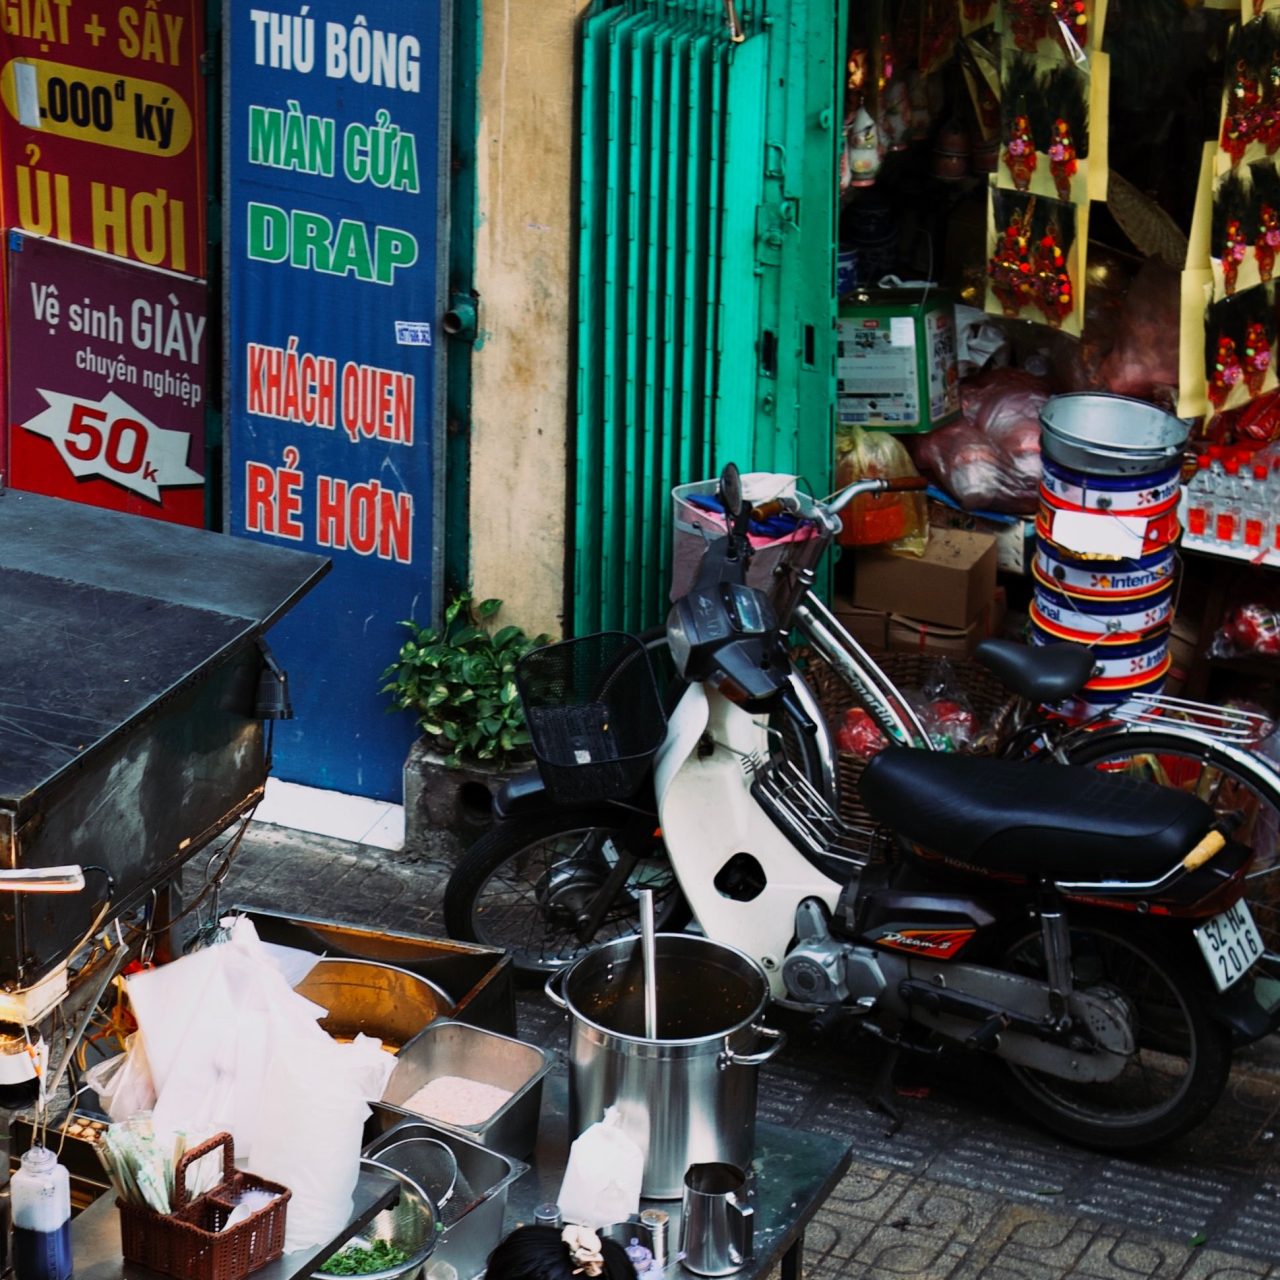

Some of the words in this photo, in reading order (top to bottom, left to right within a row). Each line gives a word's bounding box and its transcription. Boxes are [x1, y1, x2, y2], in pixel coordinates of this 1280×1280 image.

[250, 5, 315, 74] THÚ
[326, 15, 420, 92] BÔNG
[134, 93, 174, 150] ký
[249, 100, 335, 177] MÀN
[344, 109, 419, 192] CỬA
[16, 143, 72, 243] ỦI
[91, 181, 186, 272] HƠI
[247, 201, 418, 285] DRAP
[31, 282, 60, 335] Vệ
[68, 297, 124, 344] sinh
[130, 293, 207, 365] GIÀY
[76, 346, 137, 383] chuyên
[143, 369, 201, 408] nghiệp
[246, 336, 336, 429] KHÁCH
[341, 361, 415, 446] QUEN
[246, 446, 304, 541] RẺ
[317, 476, 413, 564] HƠN
[1219, 929, 1258, 983] 2016
